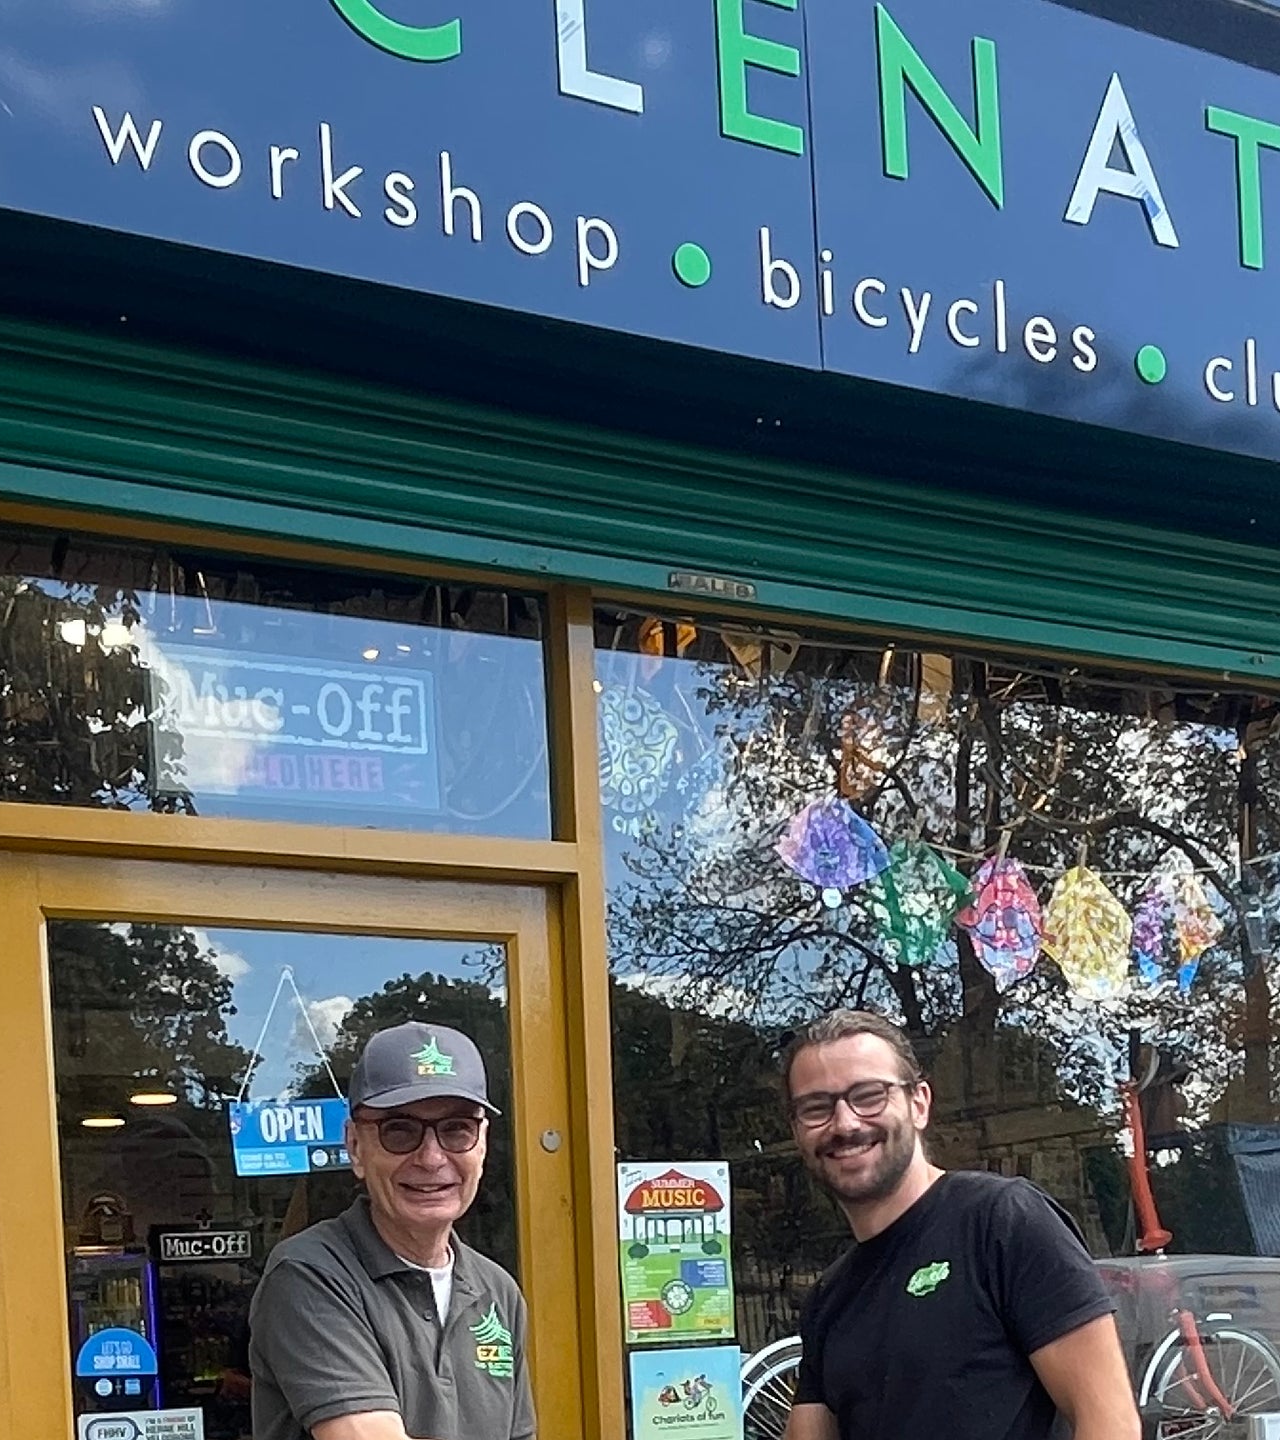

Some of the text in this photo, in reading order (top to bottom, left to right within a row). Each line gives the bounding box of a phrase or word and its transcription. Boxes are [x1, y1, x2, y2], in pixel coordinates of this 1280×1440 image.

[92, 105, 620, 287] workshop
[759, 226, 1099, 374] bicycles
[260, 1106, 324, 1142] OPEN
[641, 1189, 705, 1208] MUSIC
[164, 1234, 247, 1256] Muc-Off
[652, 1413, 695, 1425] Chariots
